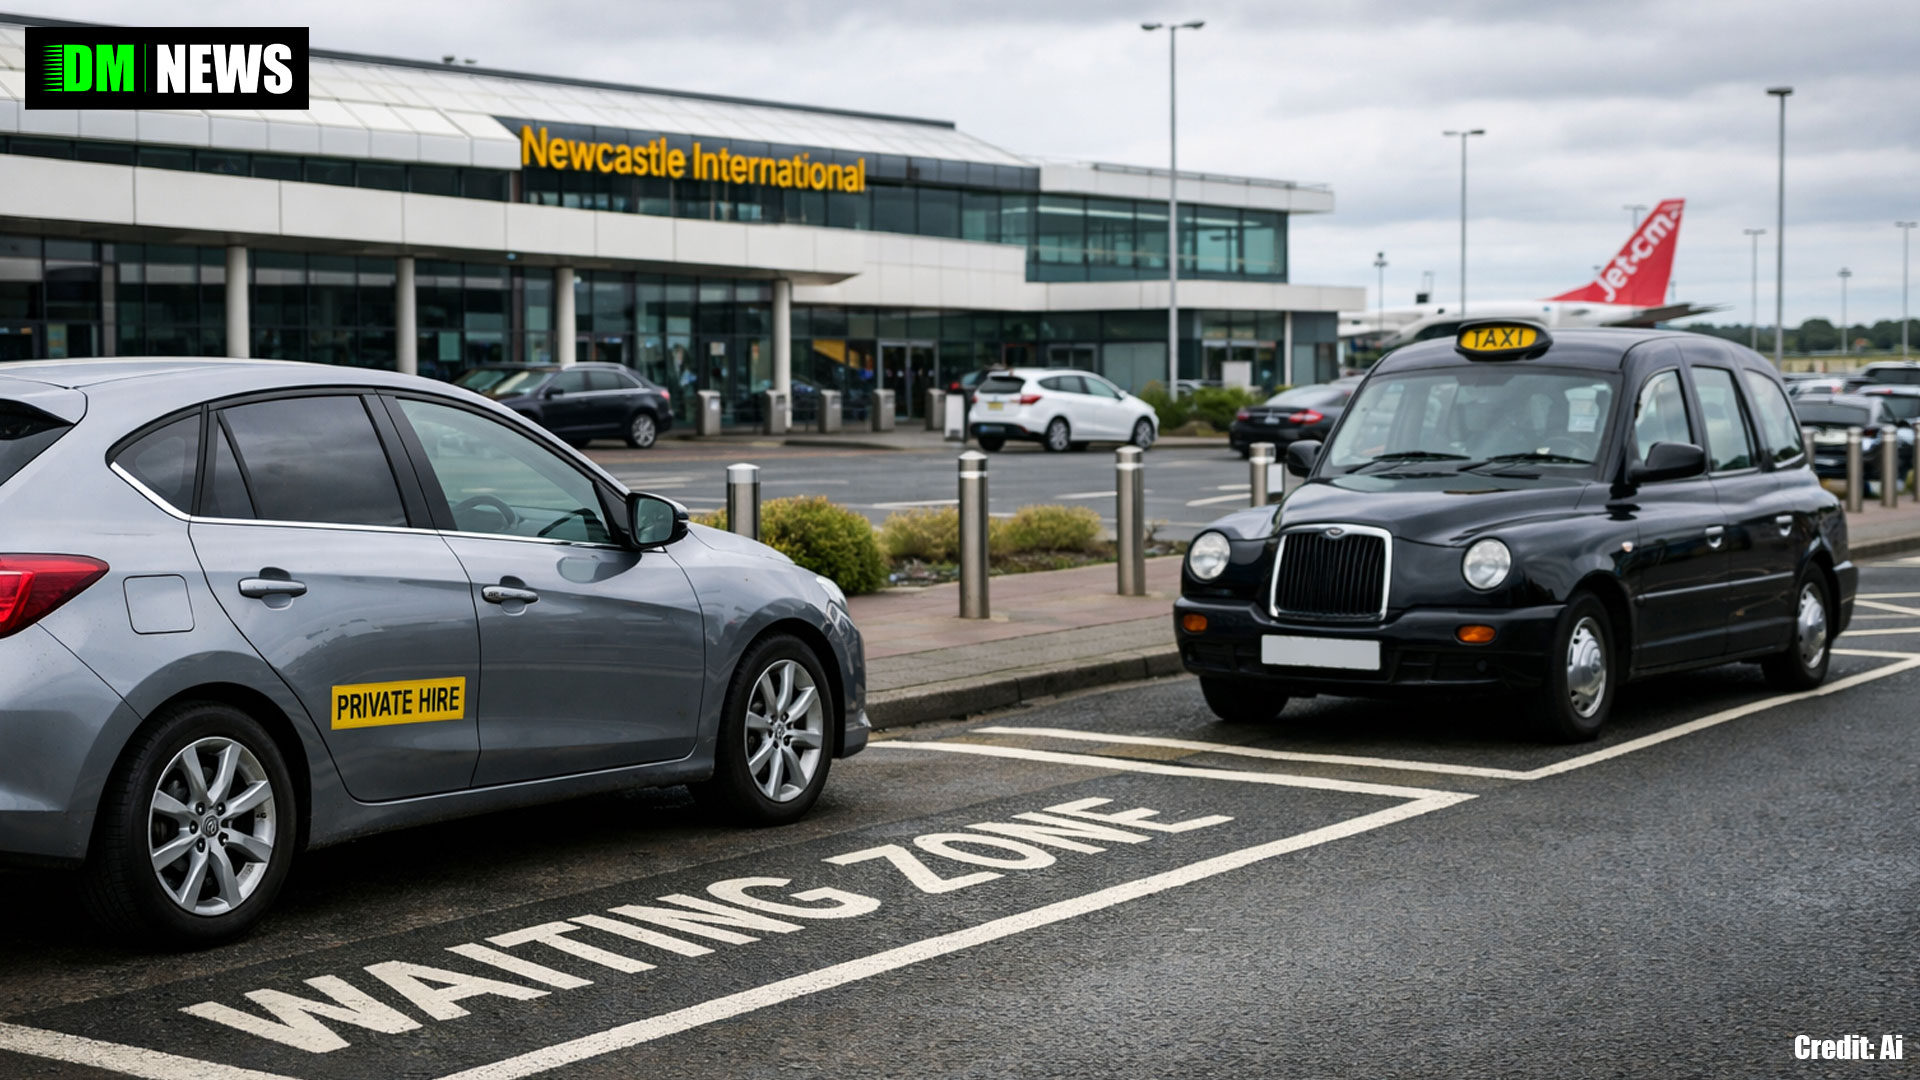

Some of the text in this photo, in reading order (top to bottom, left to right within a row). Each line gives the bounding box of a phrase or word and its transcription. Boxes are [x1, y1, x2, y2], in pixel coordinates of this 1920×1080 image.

[521, 125, 866, 193] Newcastle International
[1473, 327, 1524, 348] TAXI
[337, 686, 460, 720] PRIVATE HIRE
[178, 796, 1235, 1054] WAITING ZONE
